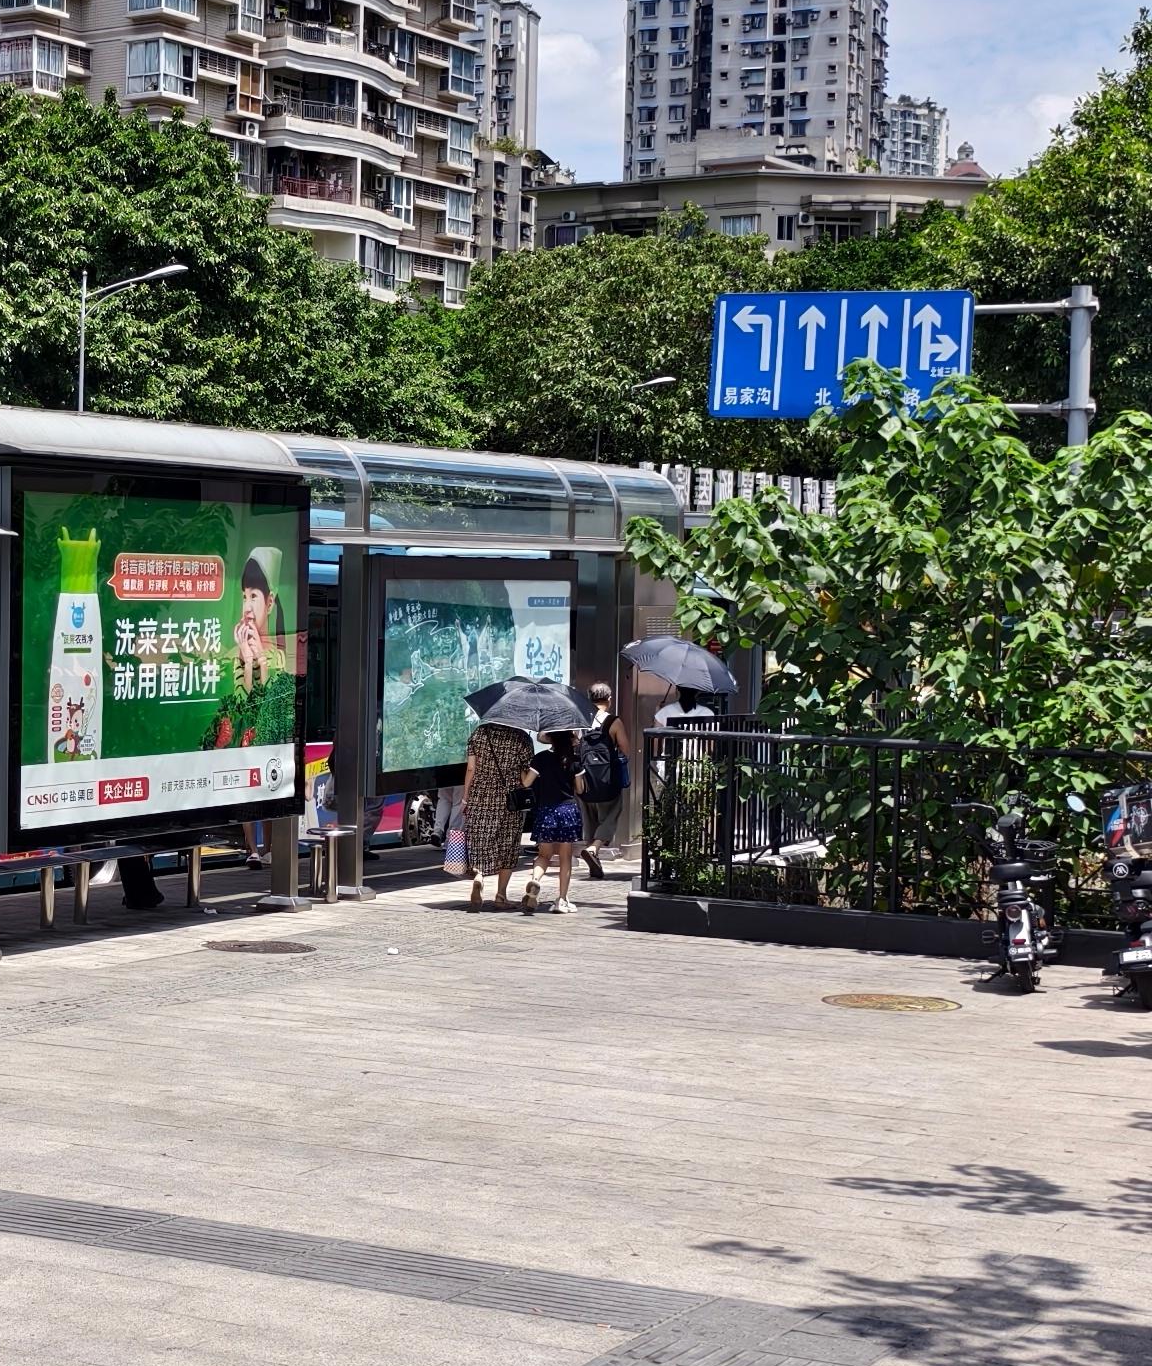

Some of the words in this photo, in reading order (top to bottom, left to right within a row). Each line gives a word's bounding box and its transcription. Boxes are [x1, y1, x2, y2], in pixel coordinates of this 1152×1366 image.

[724, 387, 771, 405] 易家沟
[115, 617, 222, 656] 洗菜去农残
[114, 659, 221, 701] 就用鹿小井
[28, 793, 59, 806] CNSIG
[60, 788, 94, 803] 中盐集团
[104, 781, 144, 800] 央企出品
